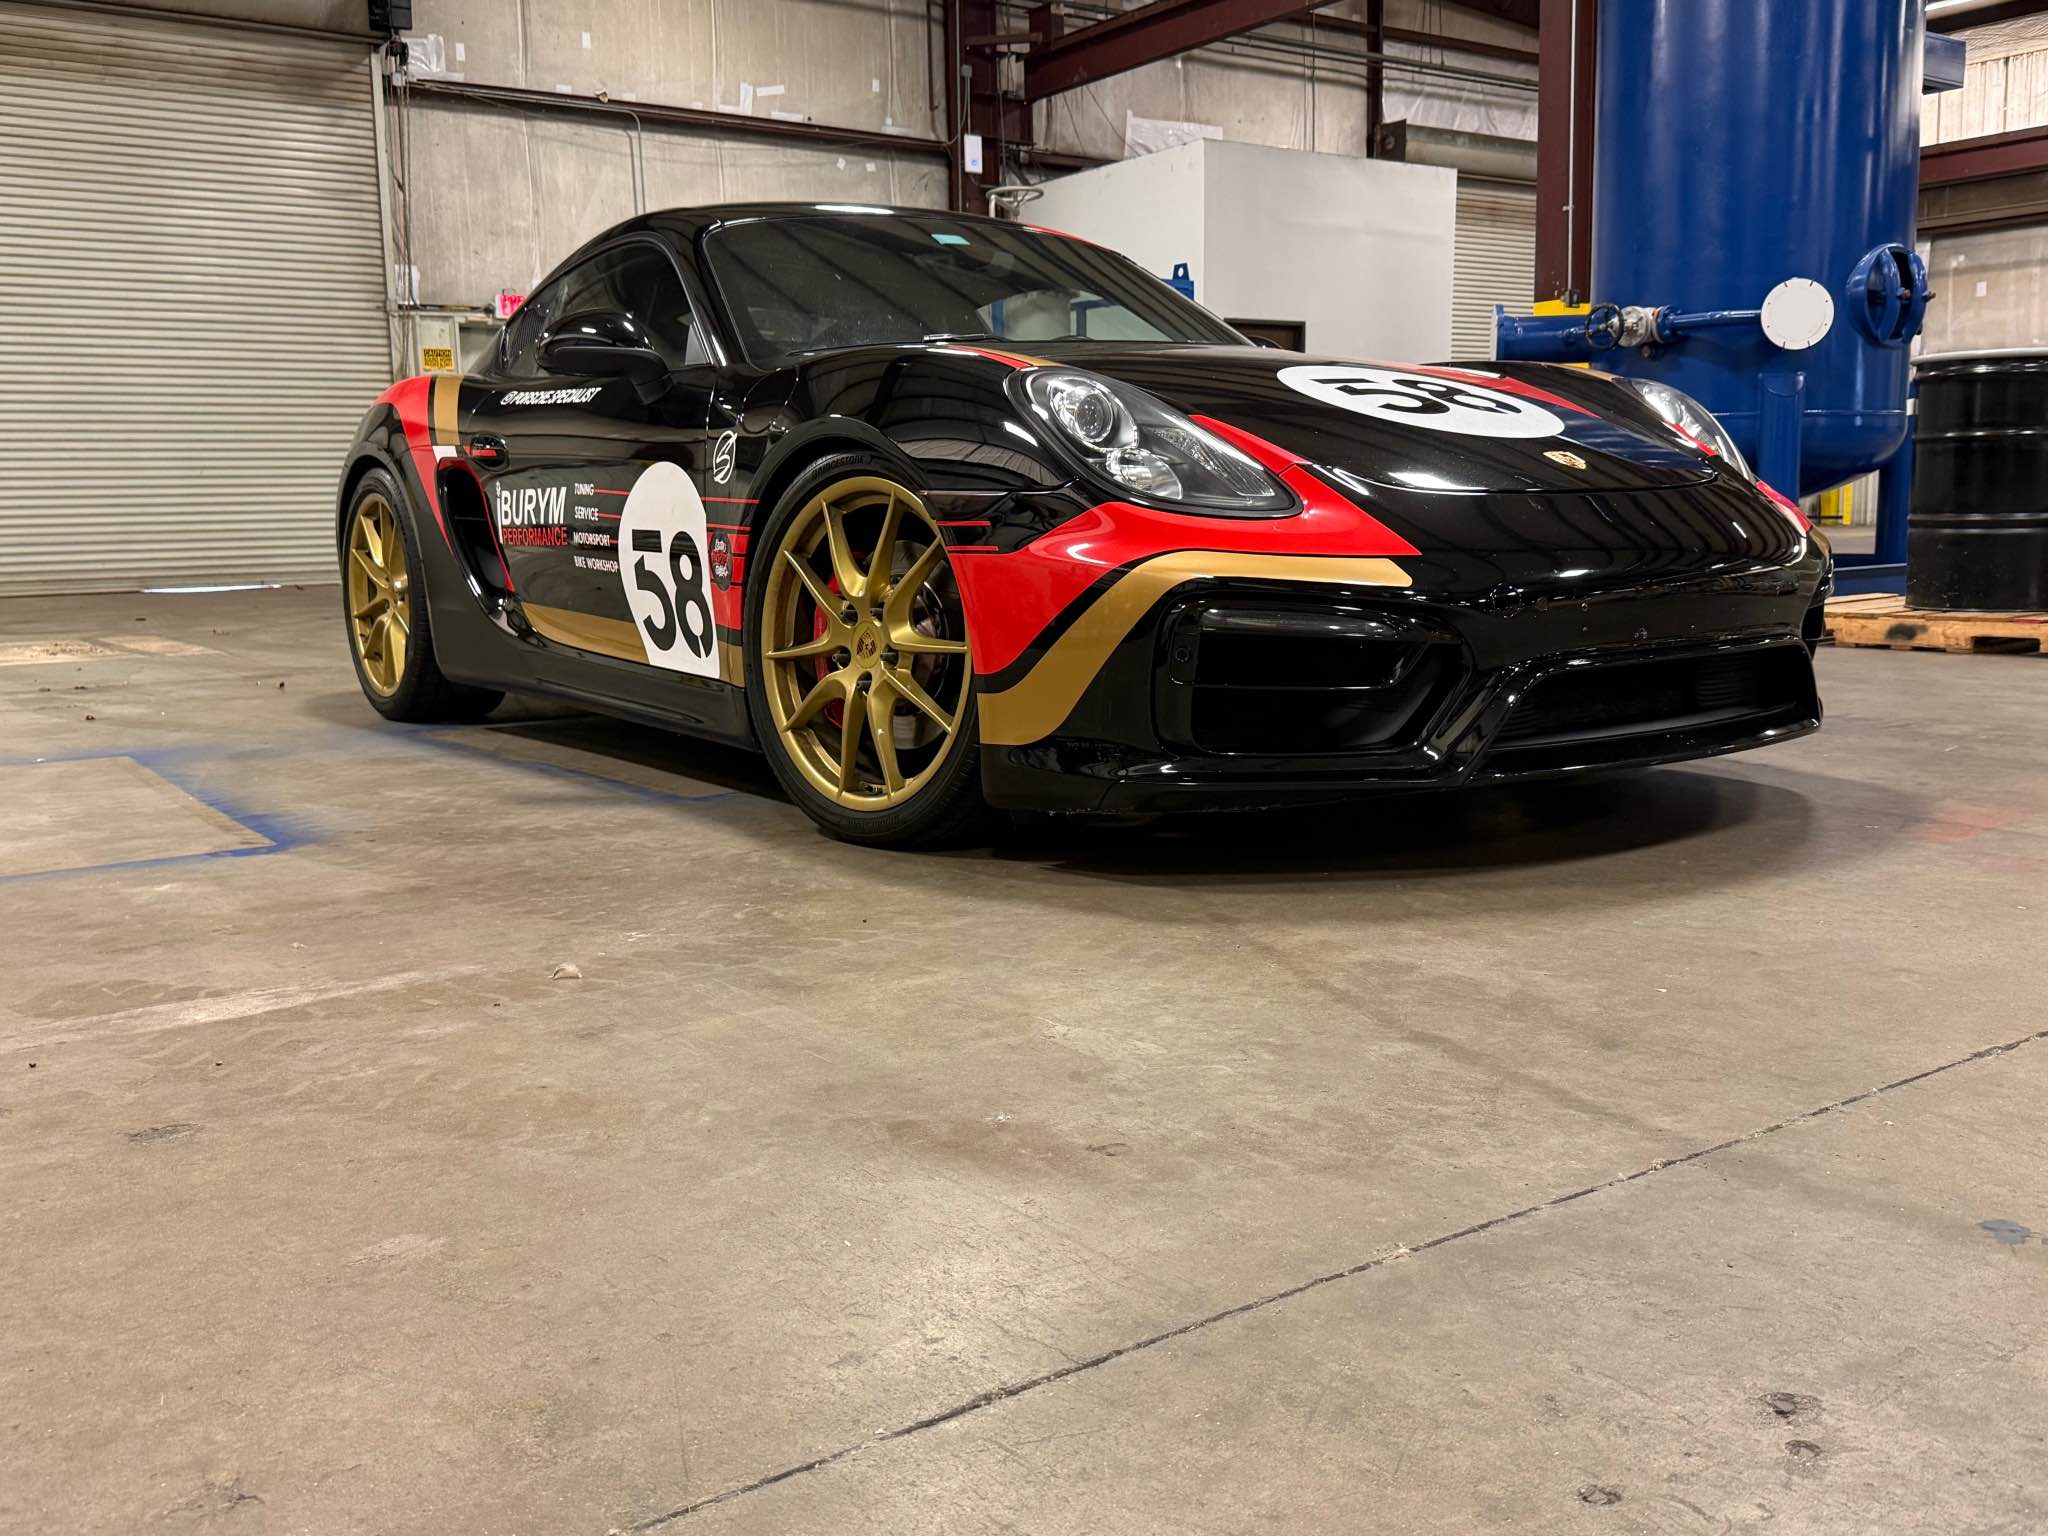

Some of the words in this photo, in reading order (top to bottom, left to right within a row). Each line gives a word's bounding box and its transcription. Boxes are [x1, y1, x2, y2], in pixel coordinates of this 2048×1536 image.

[1309, 377, 1523, 416] 58
[574, 482, 594, 496] TUNING
[574, 505, 599, 522] SERVICE
[502, 527, 568, 546] PERFORMANCE
[573, 531, 611, 548] MOTORSPORT
[573, 555, 587, 570] BIKE
[586, 557, 619, 574] WORKSHOP
[632, 528, 715, 660] 58
